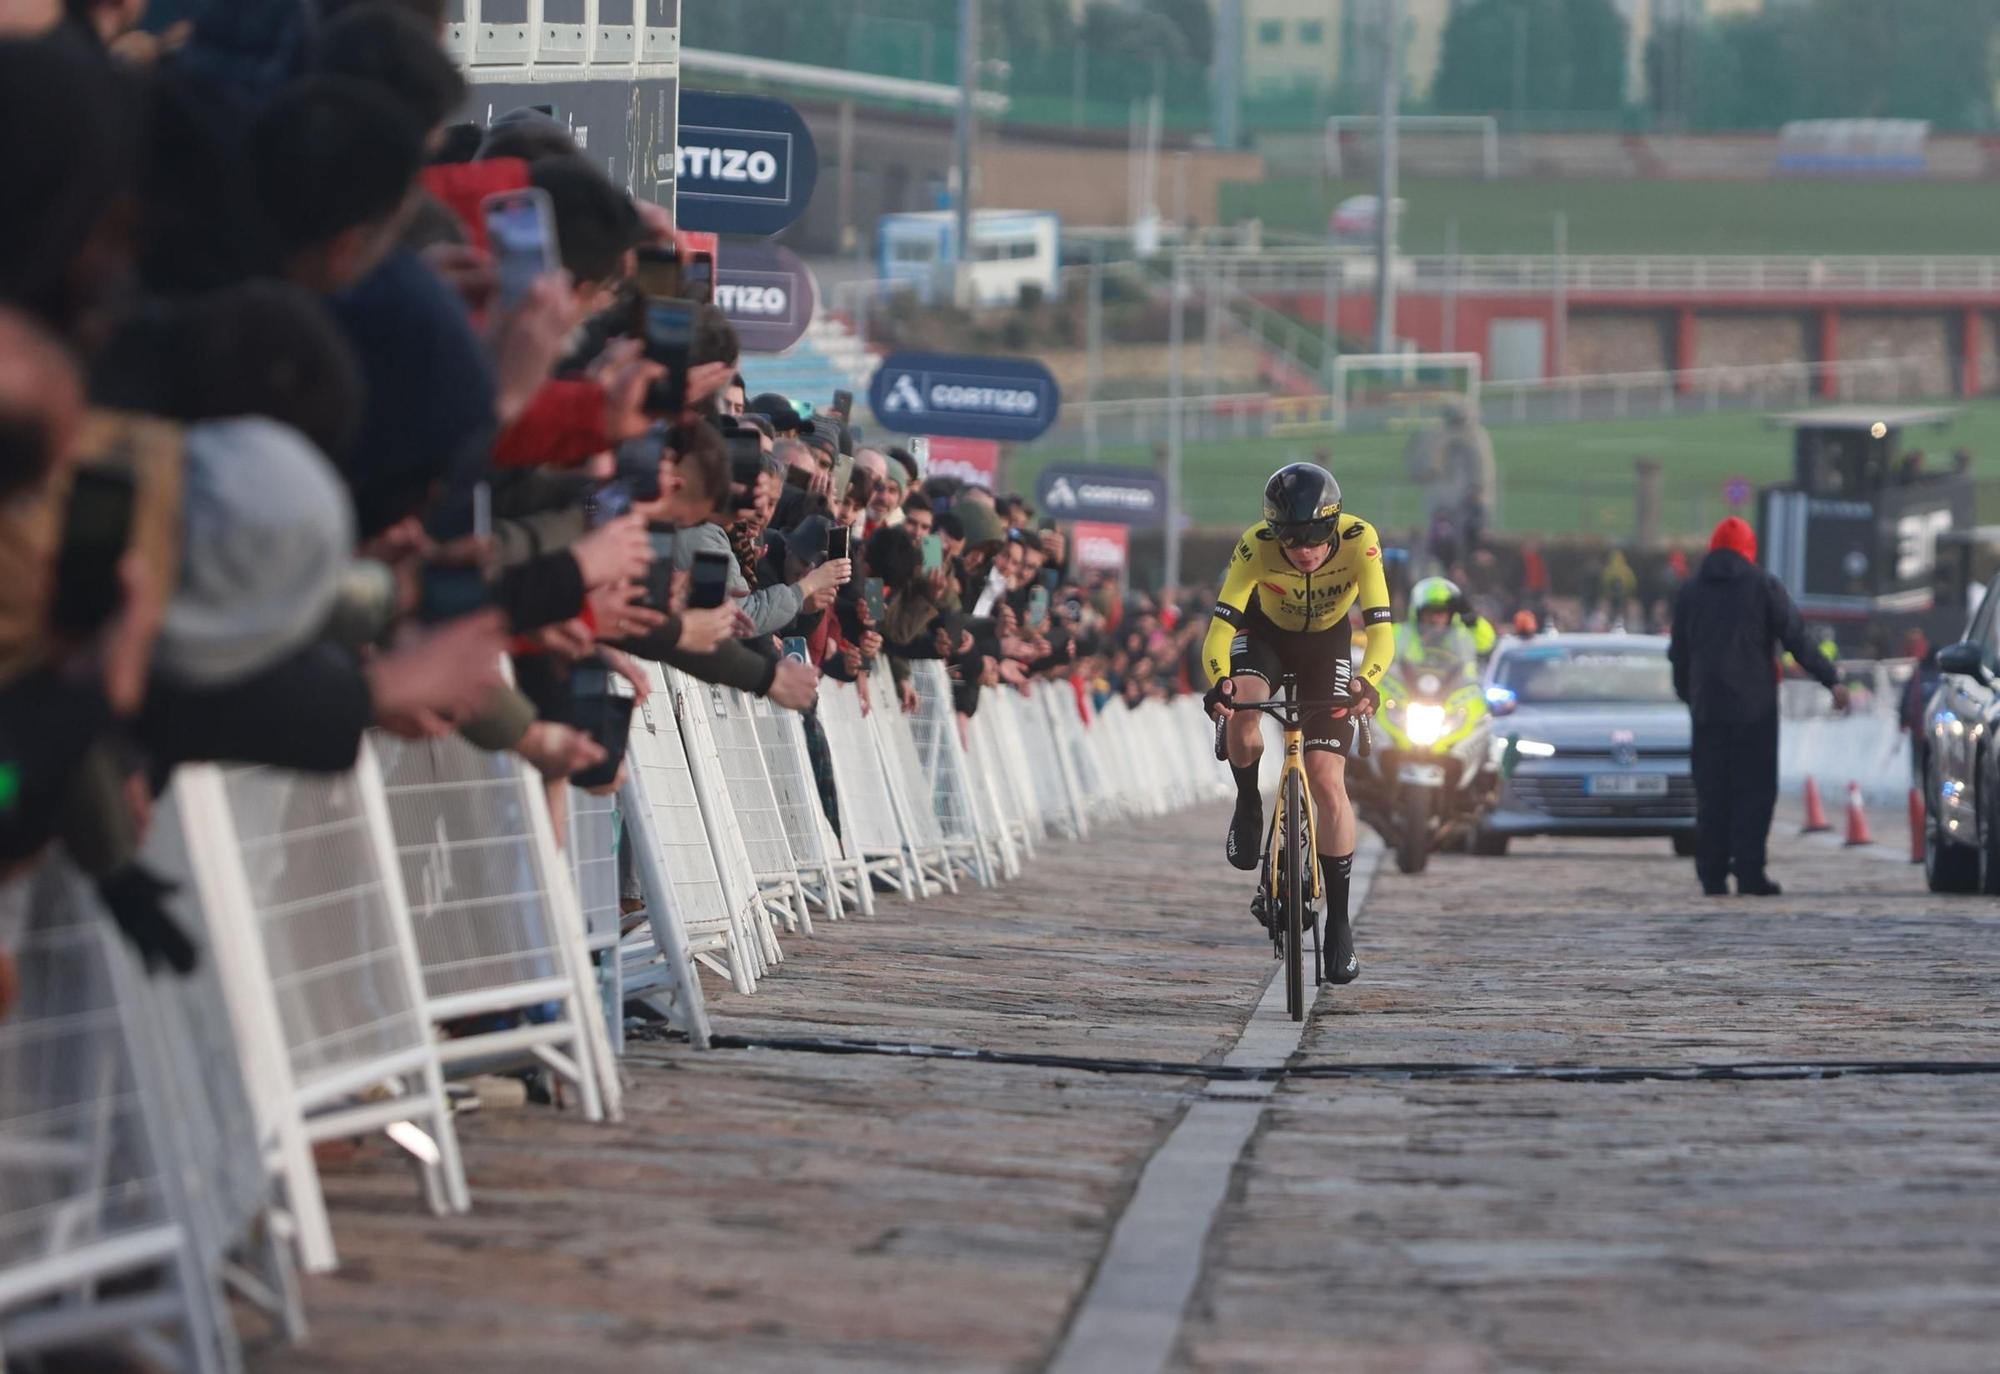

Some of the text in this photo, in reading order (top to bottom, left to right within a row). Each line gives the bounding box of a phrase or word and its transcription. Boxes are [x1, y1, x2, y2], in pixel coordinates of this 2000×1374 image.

[931, 384, 1037, 414] CORTIZO
[1078, 484, 1154, 505] CORTIZO
[1293, 581, 1353, 600] VISMA
[1333, 658, 1351, 697] VISMA
